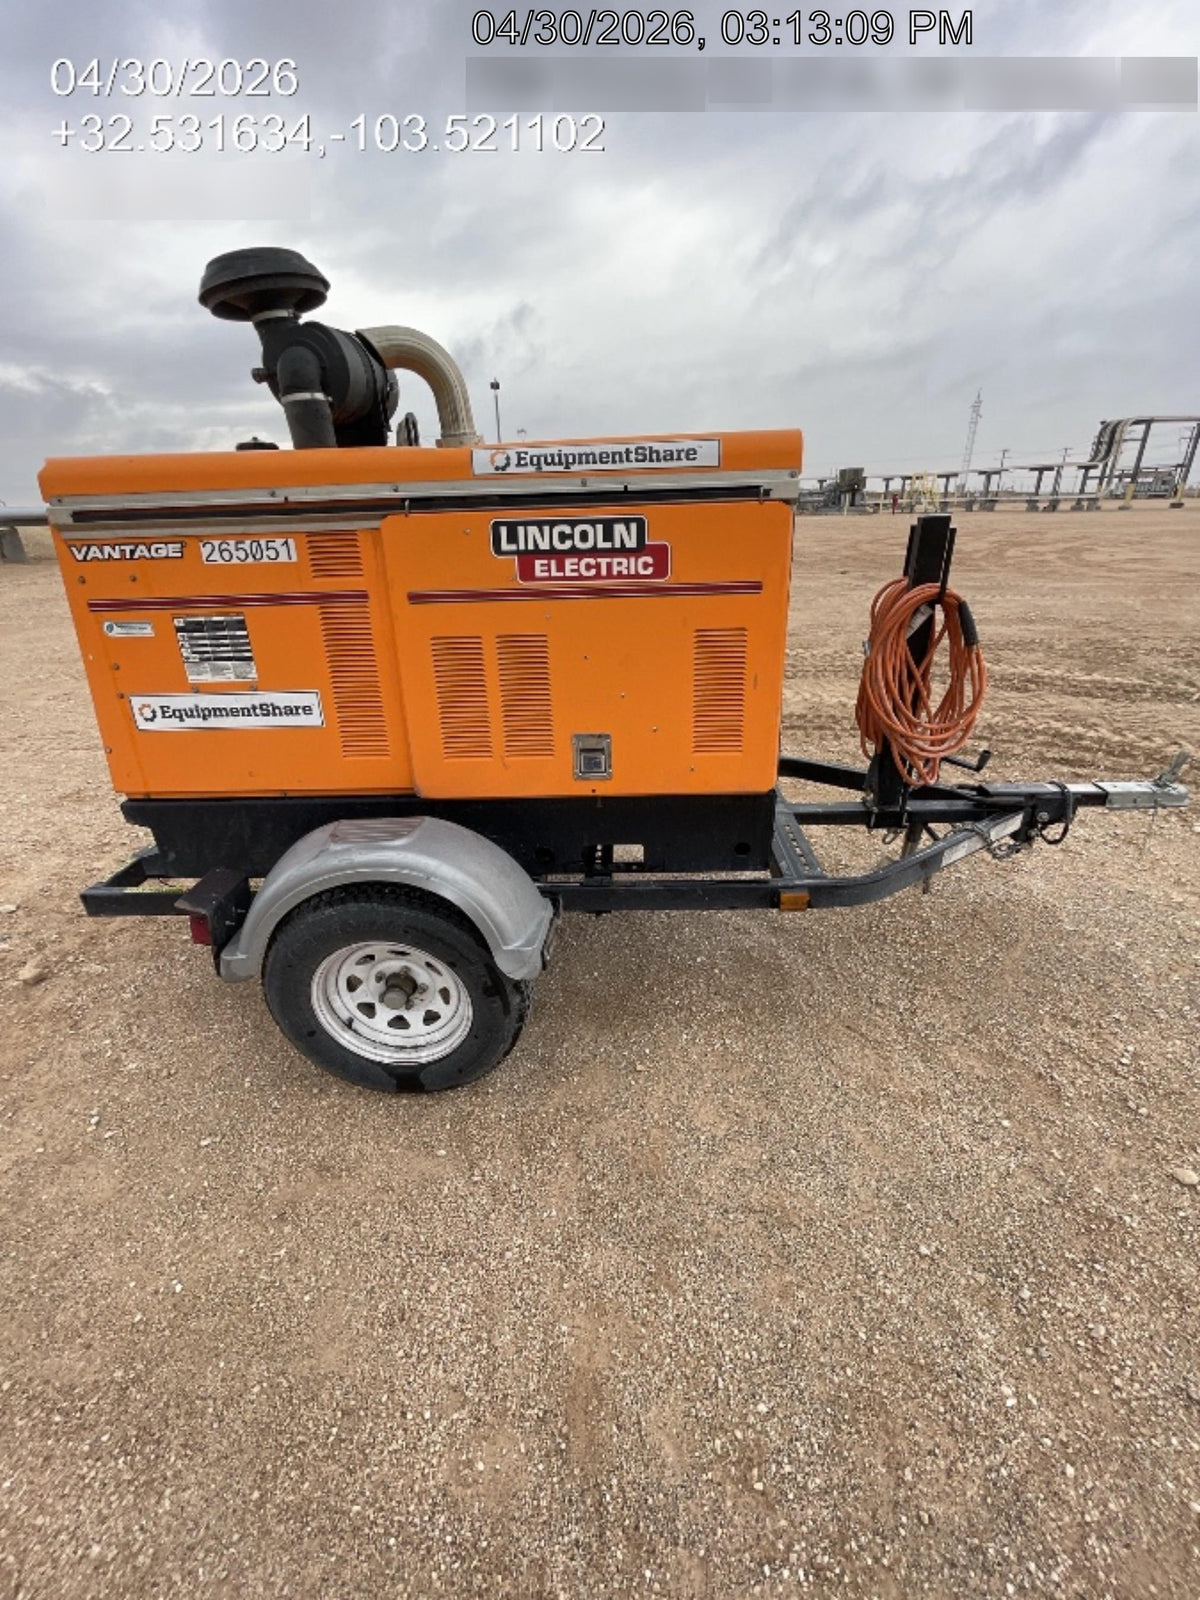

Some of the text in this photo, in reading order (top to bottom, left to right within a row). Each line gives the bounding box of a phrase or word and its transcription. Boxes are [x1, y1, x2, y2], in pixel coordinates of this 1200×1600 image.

[515, 446, 698, 471] EquipmentShare
[499, 522, 638, 551] LINCOLN
[69, 542, 184, 562] VANTAGE
[202, 540, 293, 562] 265051
[534, 556, 654, 577] ELECTRIC
[160, 703, 313, 722] EquipmentShare
